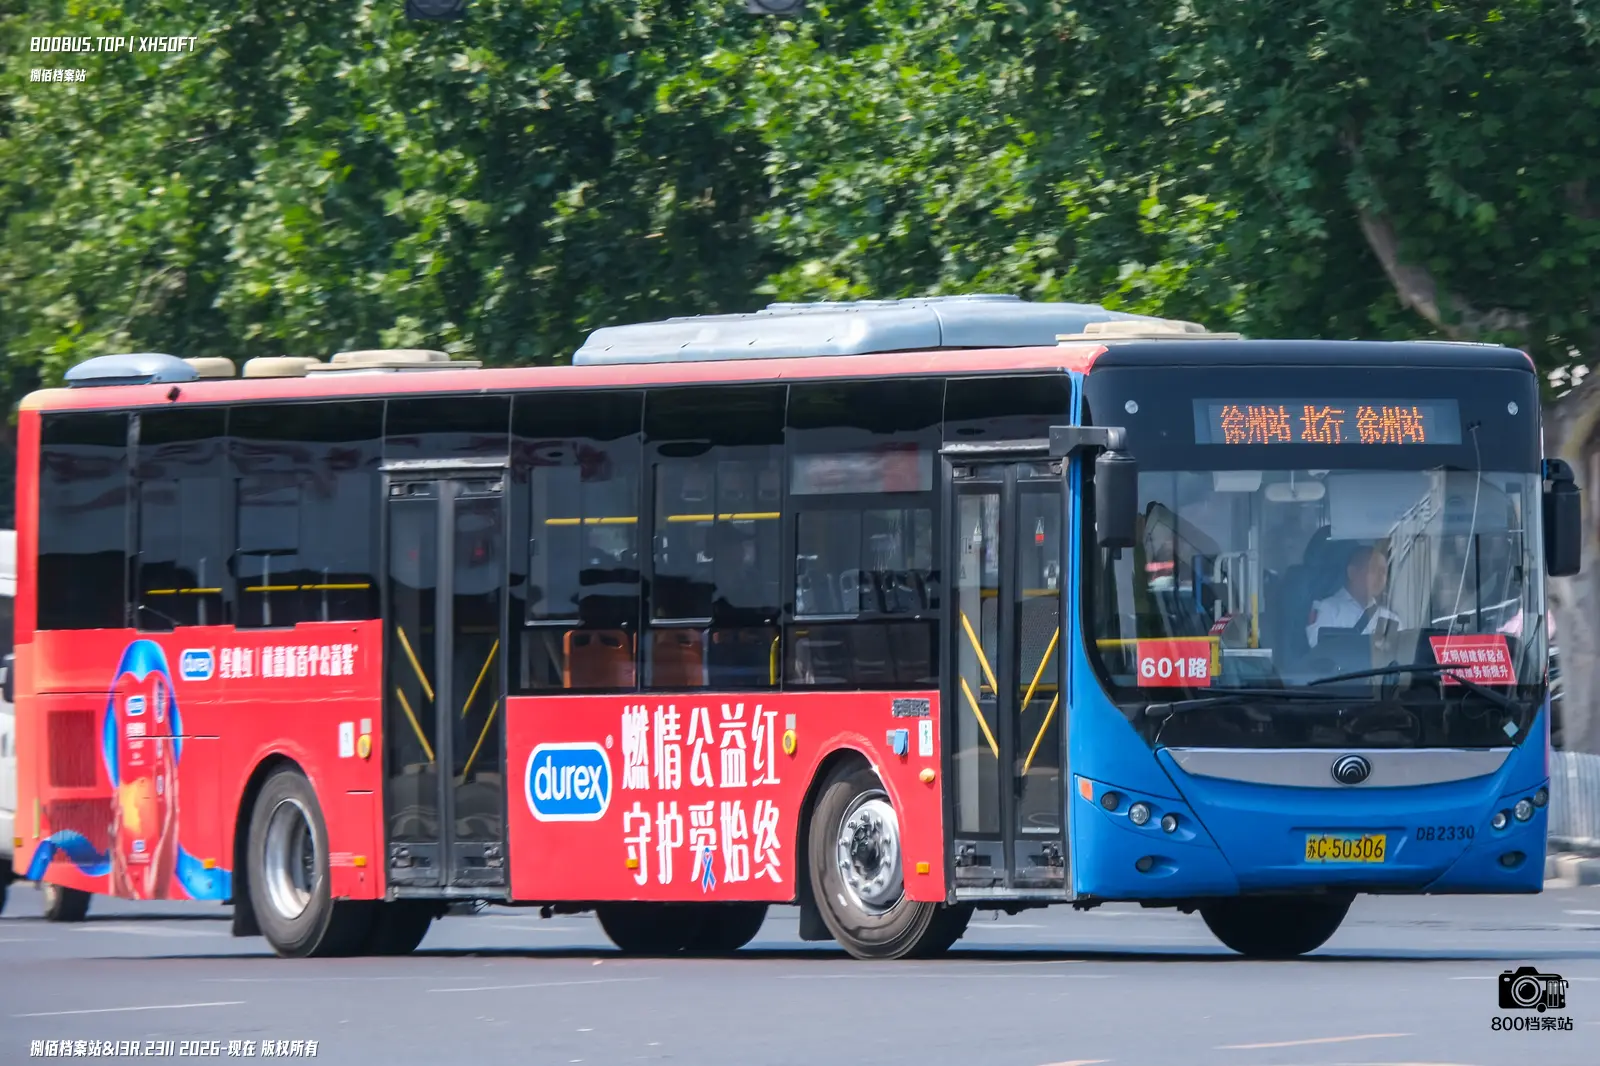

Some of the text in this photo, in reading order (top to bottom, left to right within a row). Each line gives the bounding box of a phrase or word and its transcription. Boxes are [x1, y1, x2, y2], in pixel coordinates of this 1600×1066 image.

[1220, 405, 1425, 444] 徐州站 北行 徐州站
[1141, 657, 1207, 679] 601路
[1442, 649, 1506, 663] 文明创建新起点
[621, 703, 781, 791] 燃情公益红
[534, 755, 606, 807] durex
[622, 799, 784, 891] 守护爱始终
[1416, 825, 1476, 841] DB2330
